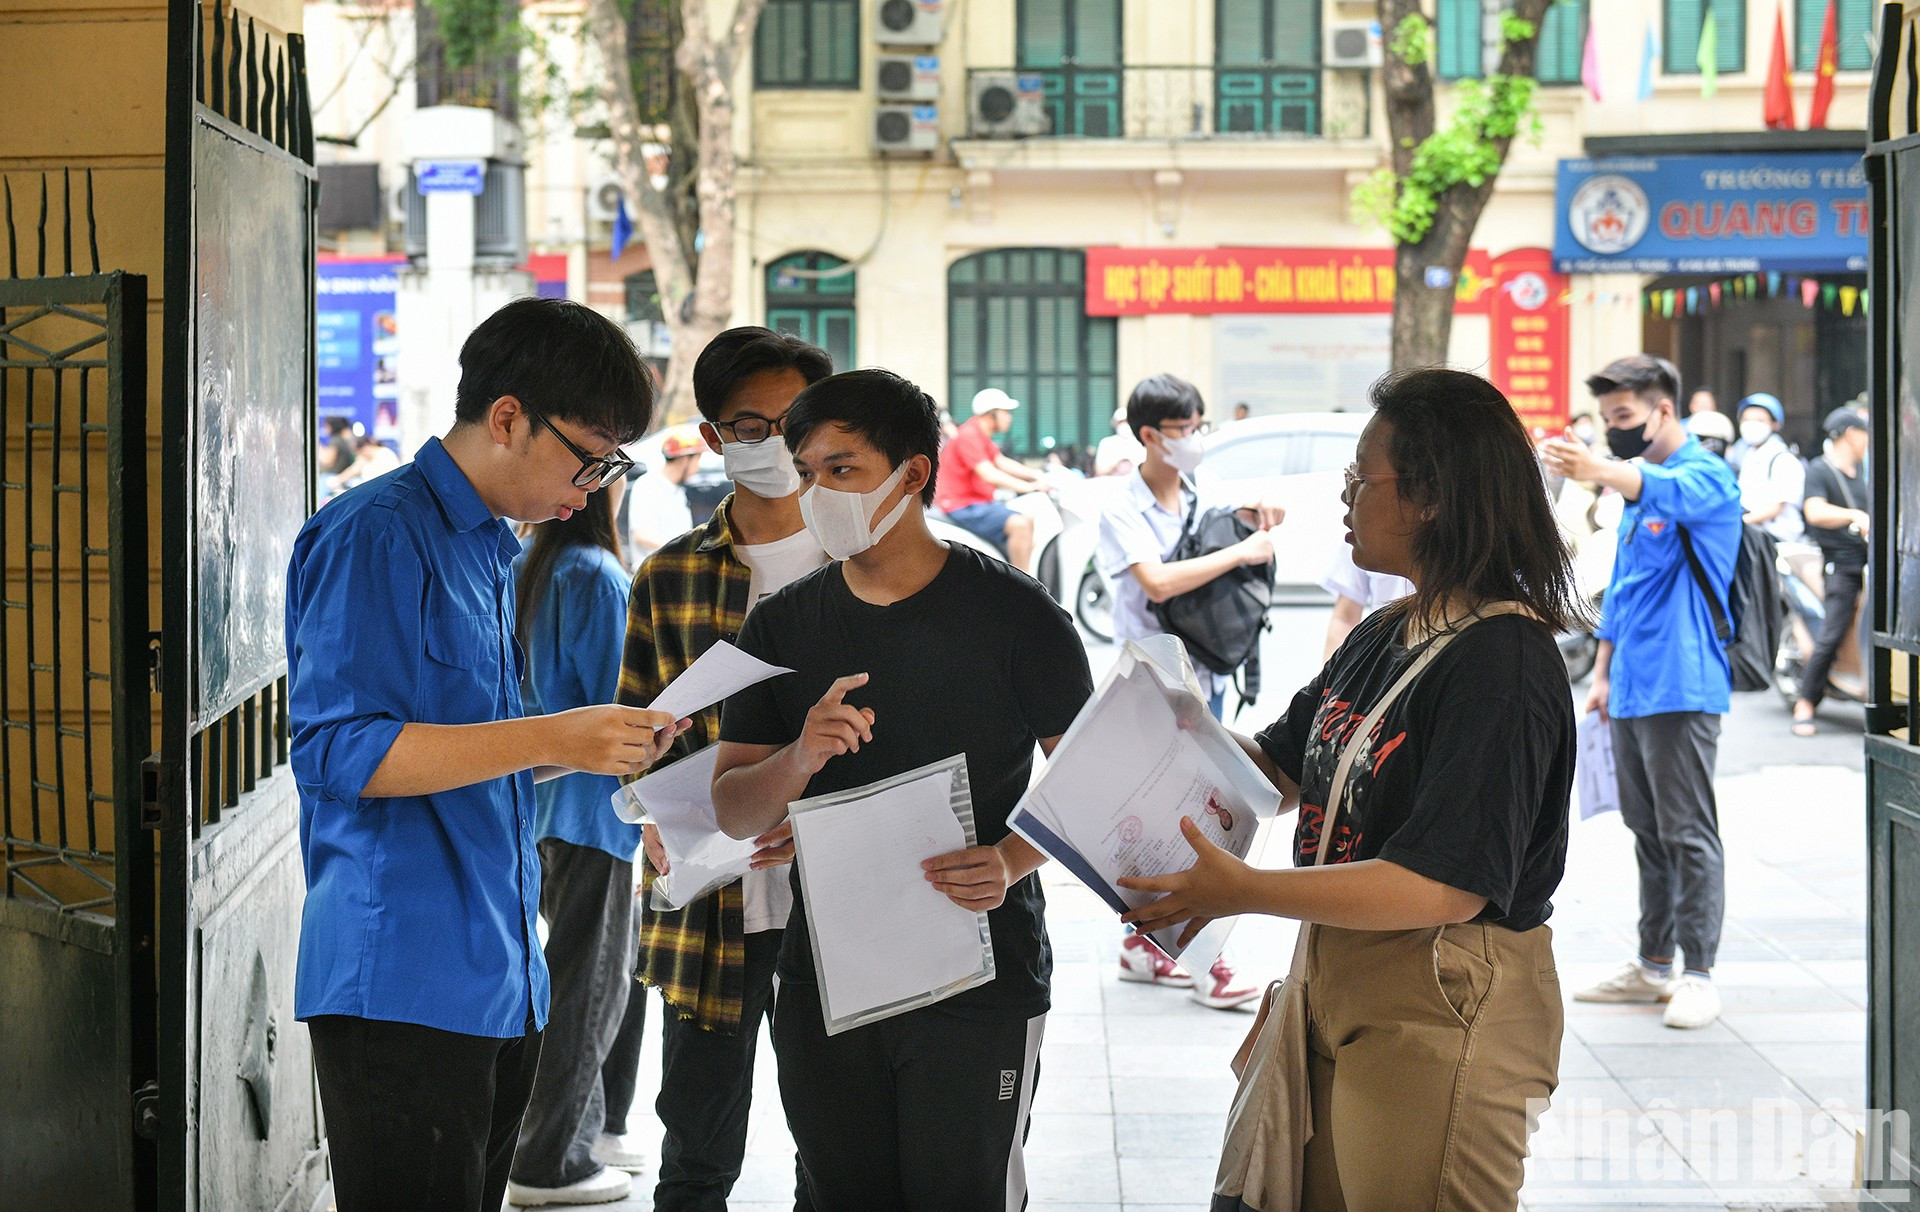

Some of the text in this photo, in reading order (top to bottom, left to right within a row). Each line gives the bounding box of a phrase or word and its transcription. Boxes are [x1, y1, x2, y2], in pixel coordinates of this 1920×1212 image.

[1660, 200, 1817, 239] QUANG
[1104, 265, 1138, 309] HỌC
[1139, 259, 1170, 309] TẬP
[1173, 255, 1212, 302] SUỐT
[1340, 255, 1374, 302] CỦA
